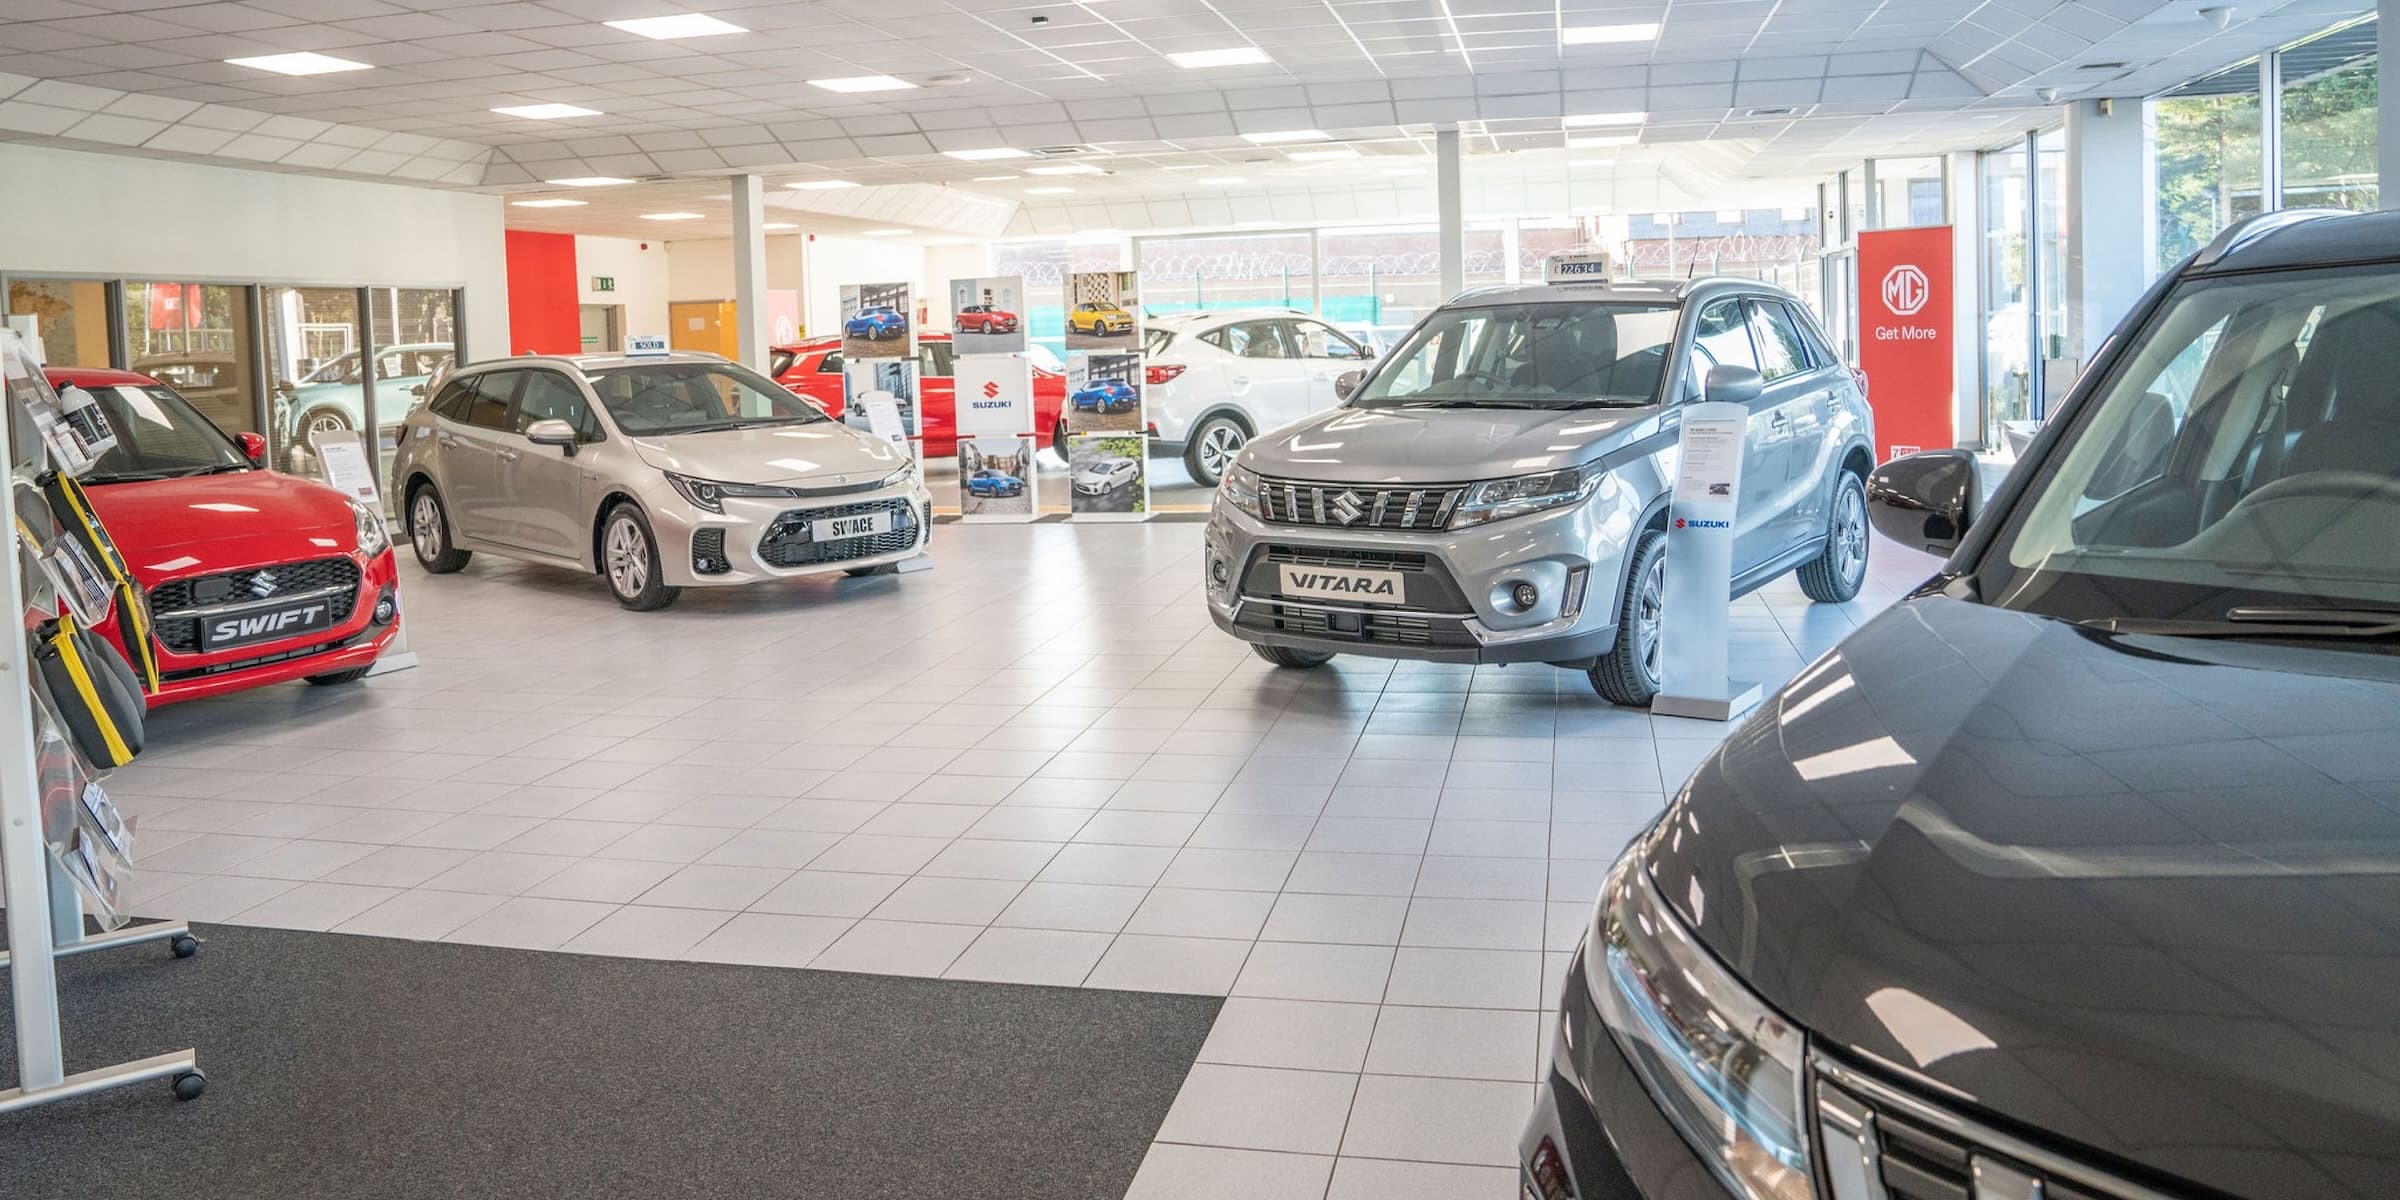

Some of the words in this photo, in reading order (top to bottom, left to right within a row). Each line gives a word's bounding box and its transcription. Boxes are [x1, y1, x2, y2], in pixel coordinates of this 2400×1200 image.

[1562, 263, 1595, 274] 22634
[1886, 268, 1924, 311] MG
[1875, 326, 1898, 340] Get
[1902, 326, 1936, 340] More
[833, 517, 873, 537] SWACE
[1688, 520, 1729, 528] SUZUKI
[1289, 572, 1394, 595] VITARA
[211, 604, 325, 641] SWIFT
